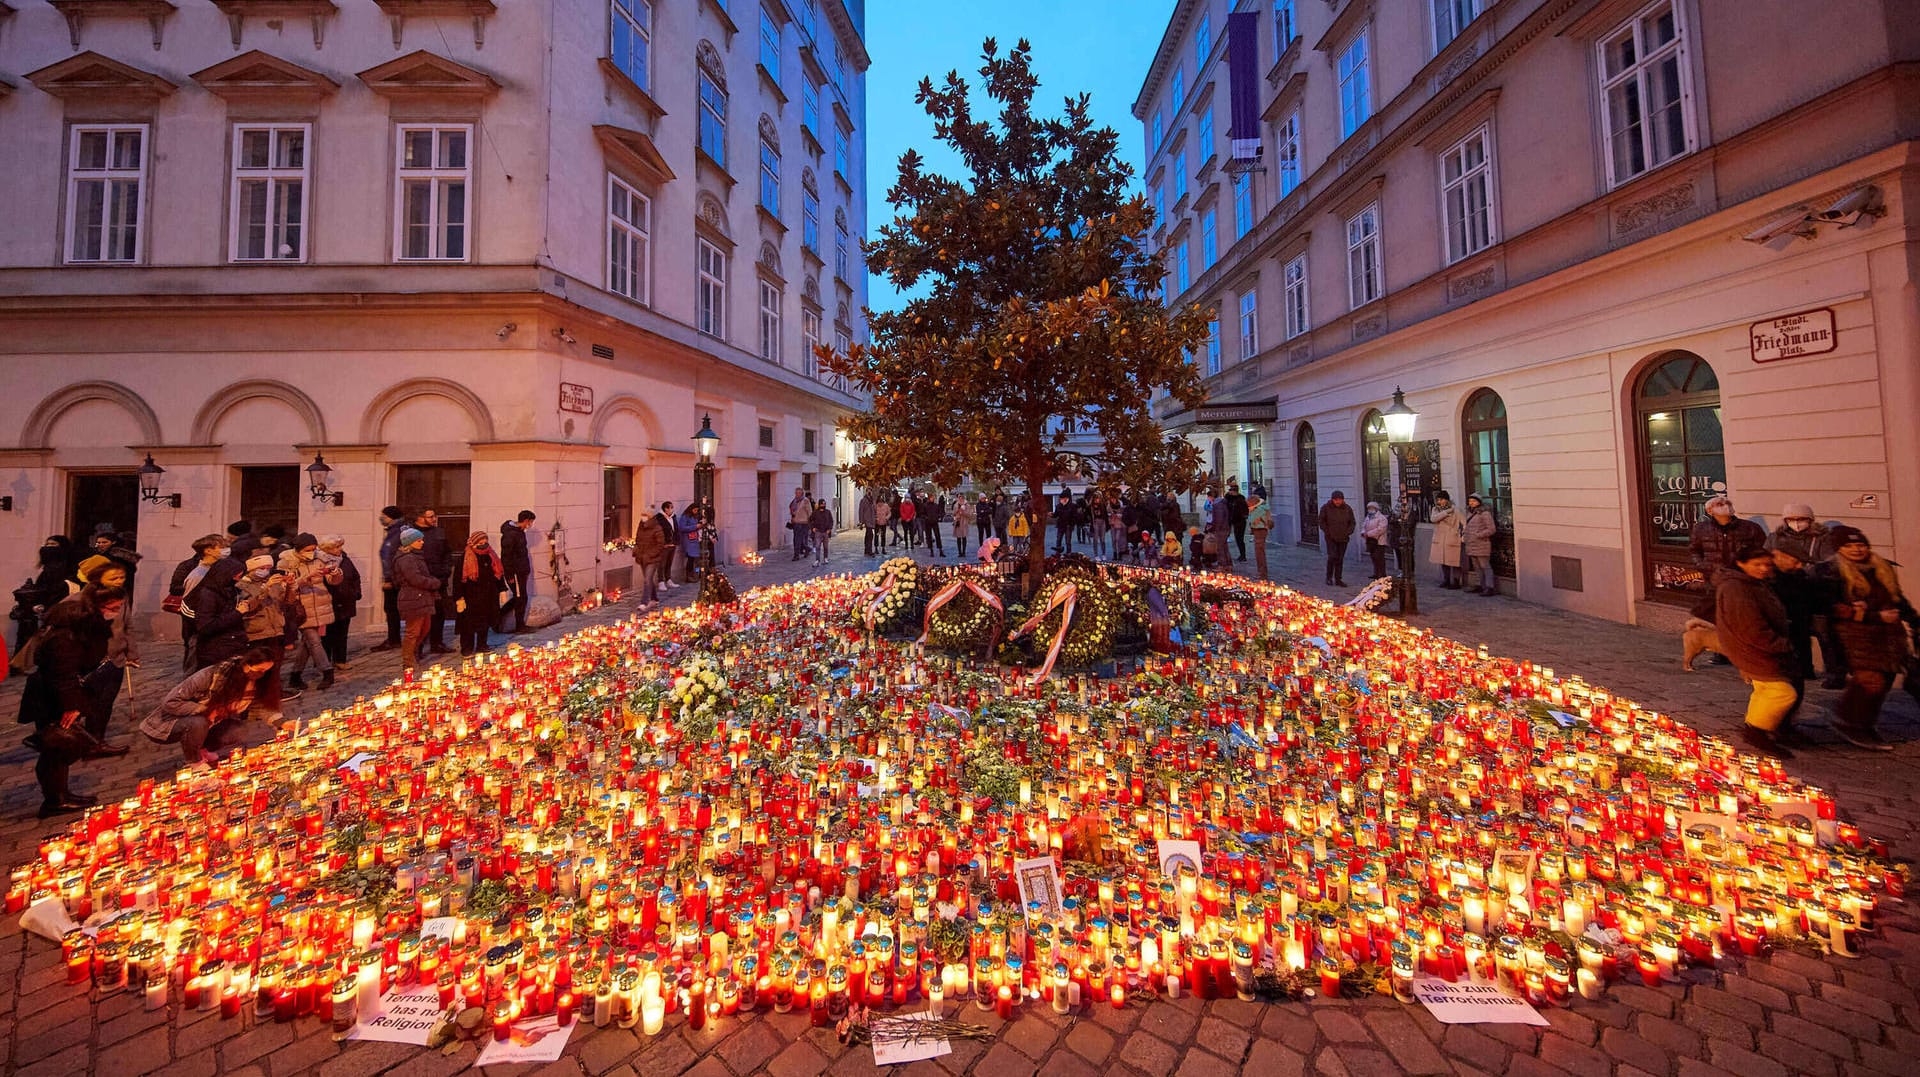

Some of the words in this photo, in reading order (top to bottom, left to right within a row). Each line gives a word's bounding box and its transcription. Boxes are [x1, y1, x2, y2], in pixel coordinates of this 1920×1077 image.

[1753, 328, 1831, 352] Friedmann-
[1200, 409, 1243, 419] Mercure
[1421, 984, 1460, 993] Nein
[1462, 985, 1498, 993] zum
[1421, 994, 1523, 1006] Terrorismus
[389, 1005, 418, 1015] has
[420, 1009, 441, 1017] no
[370, 1016, 436, 1031] Religion
